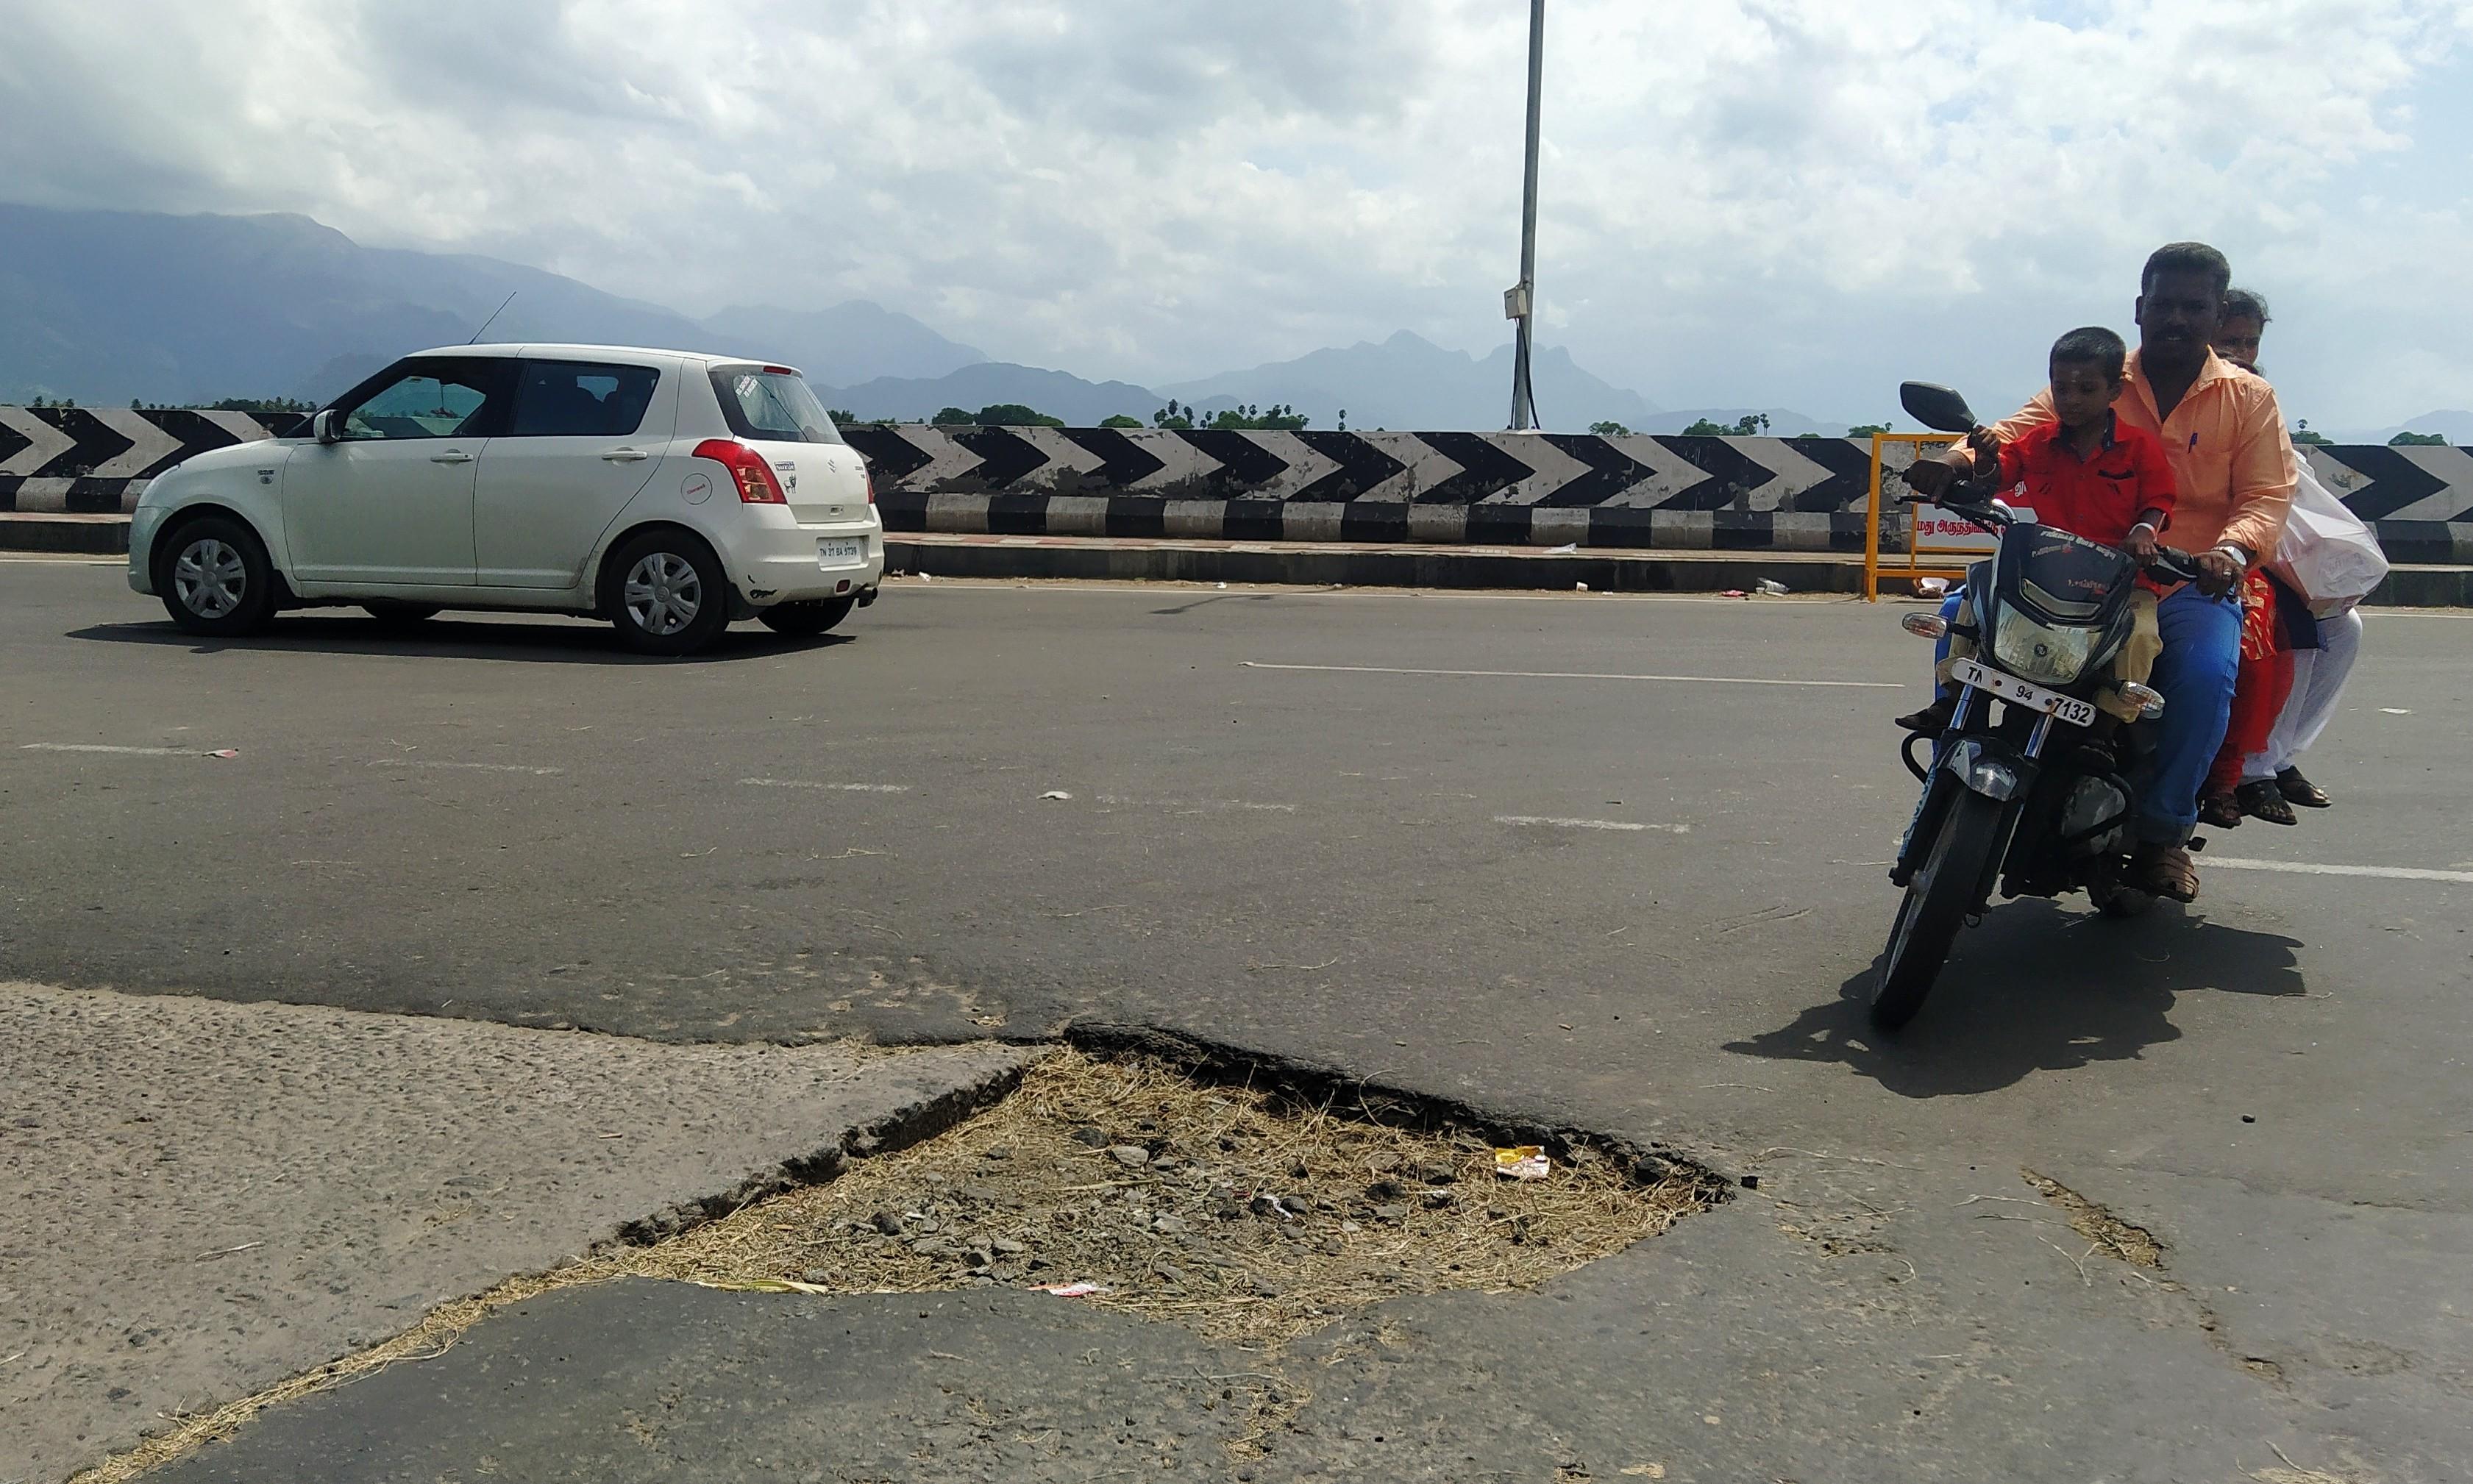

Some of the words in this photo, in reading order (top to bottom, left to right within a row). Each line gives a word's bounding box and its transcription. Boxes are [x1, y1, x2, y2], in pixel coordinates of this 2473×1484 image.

[819, 548, 827, 557] TN
[828, 548, 835, 557] 37
[2015, 685, 2034, 701] 94
[2051, 696, 2091, 724] 7132
